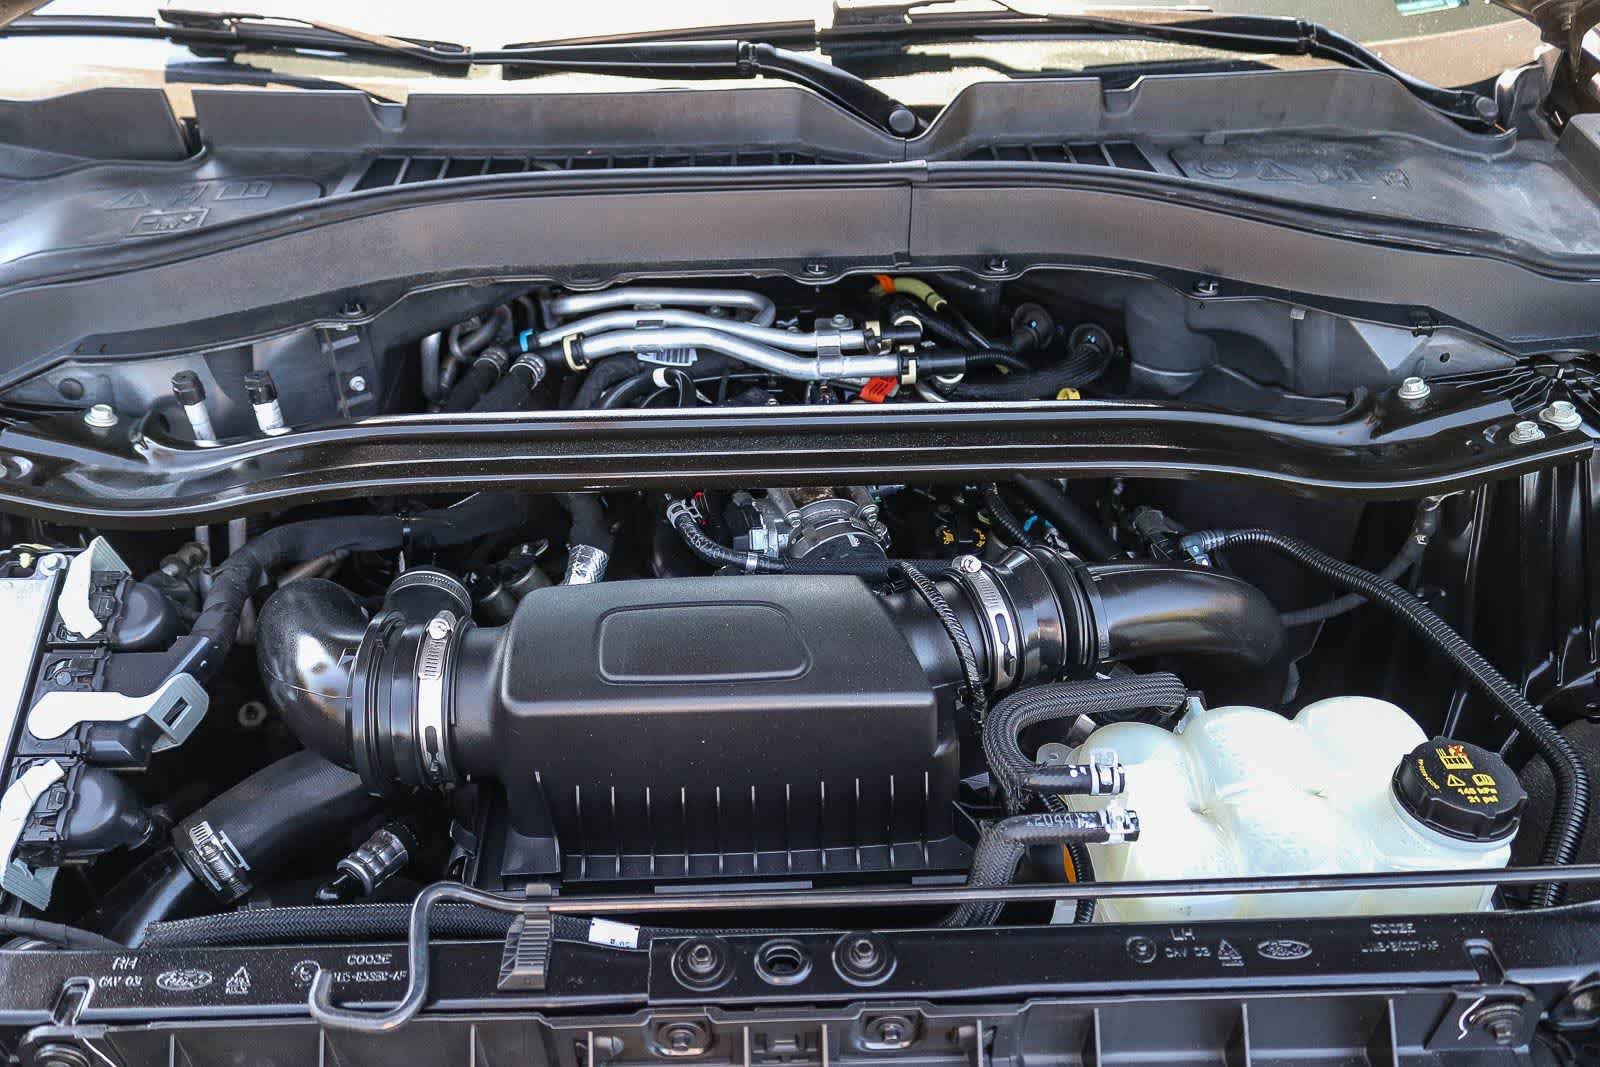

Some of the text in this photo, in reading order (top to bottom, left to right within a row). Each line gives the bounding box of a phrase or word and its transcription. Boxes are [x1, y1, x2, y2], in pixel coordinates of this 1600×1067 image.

[1170, 928, 1195, 941] LH
[111, 957, 138, 970] RH
[160, 970, 210, 989] Ford
